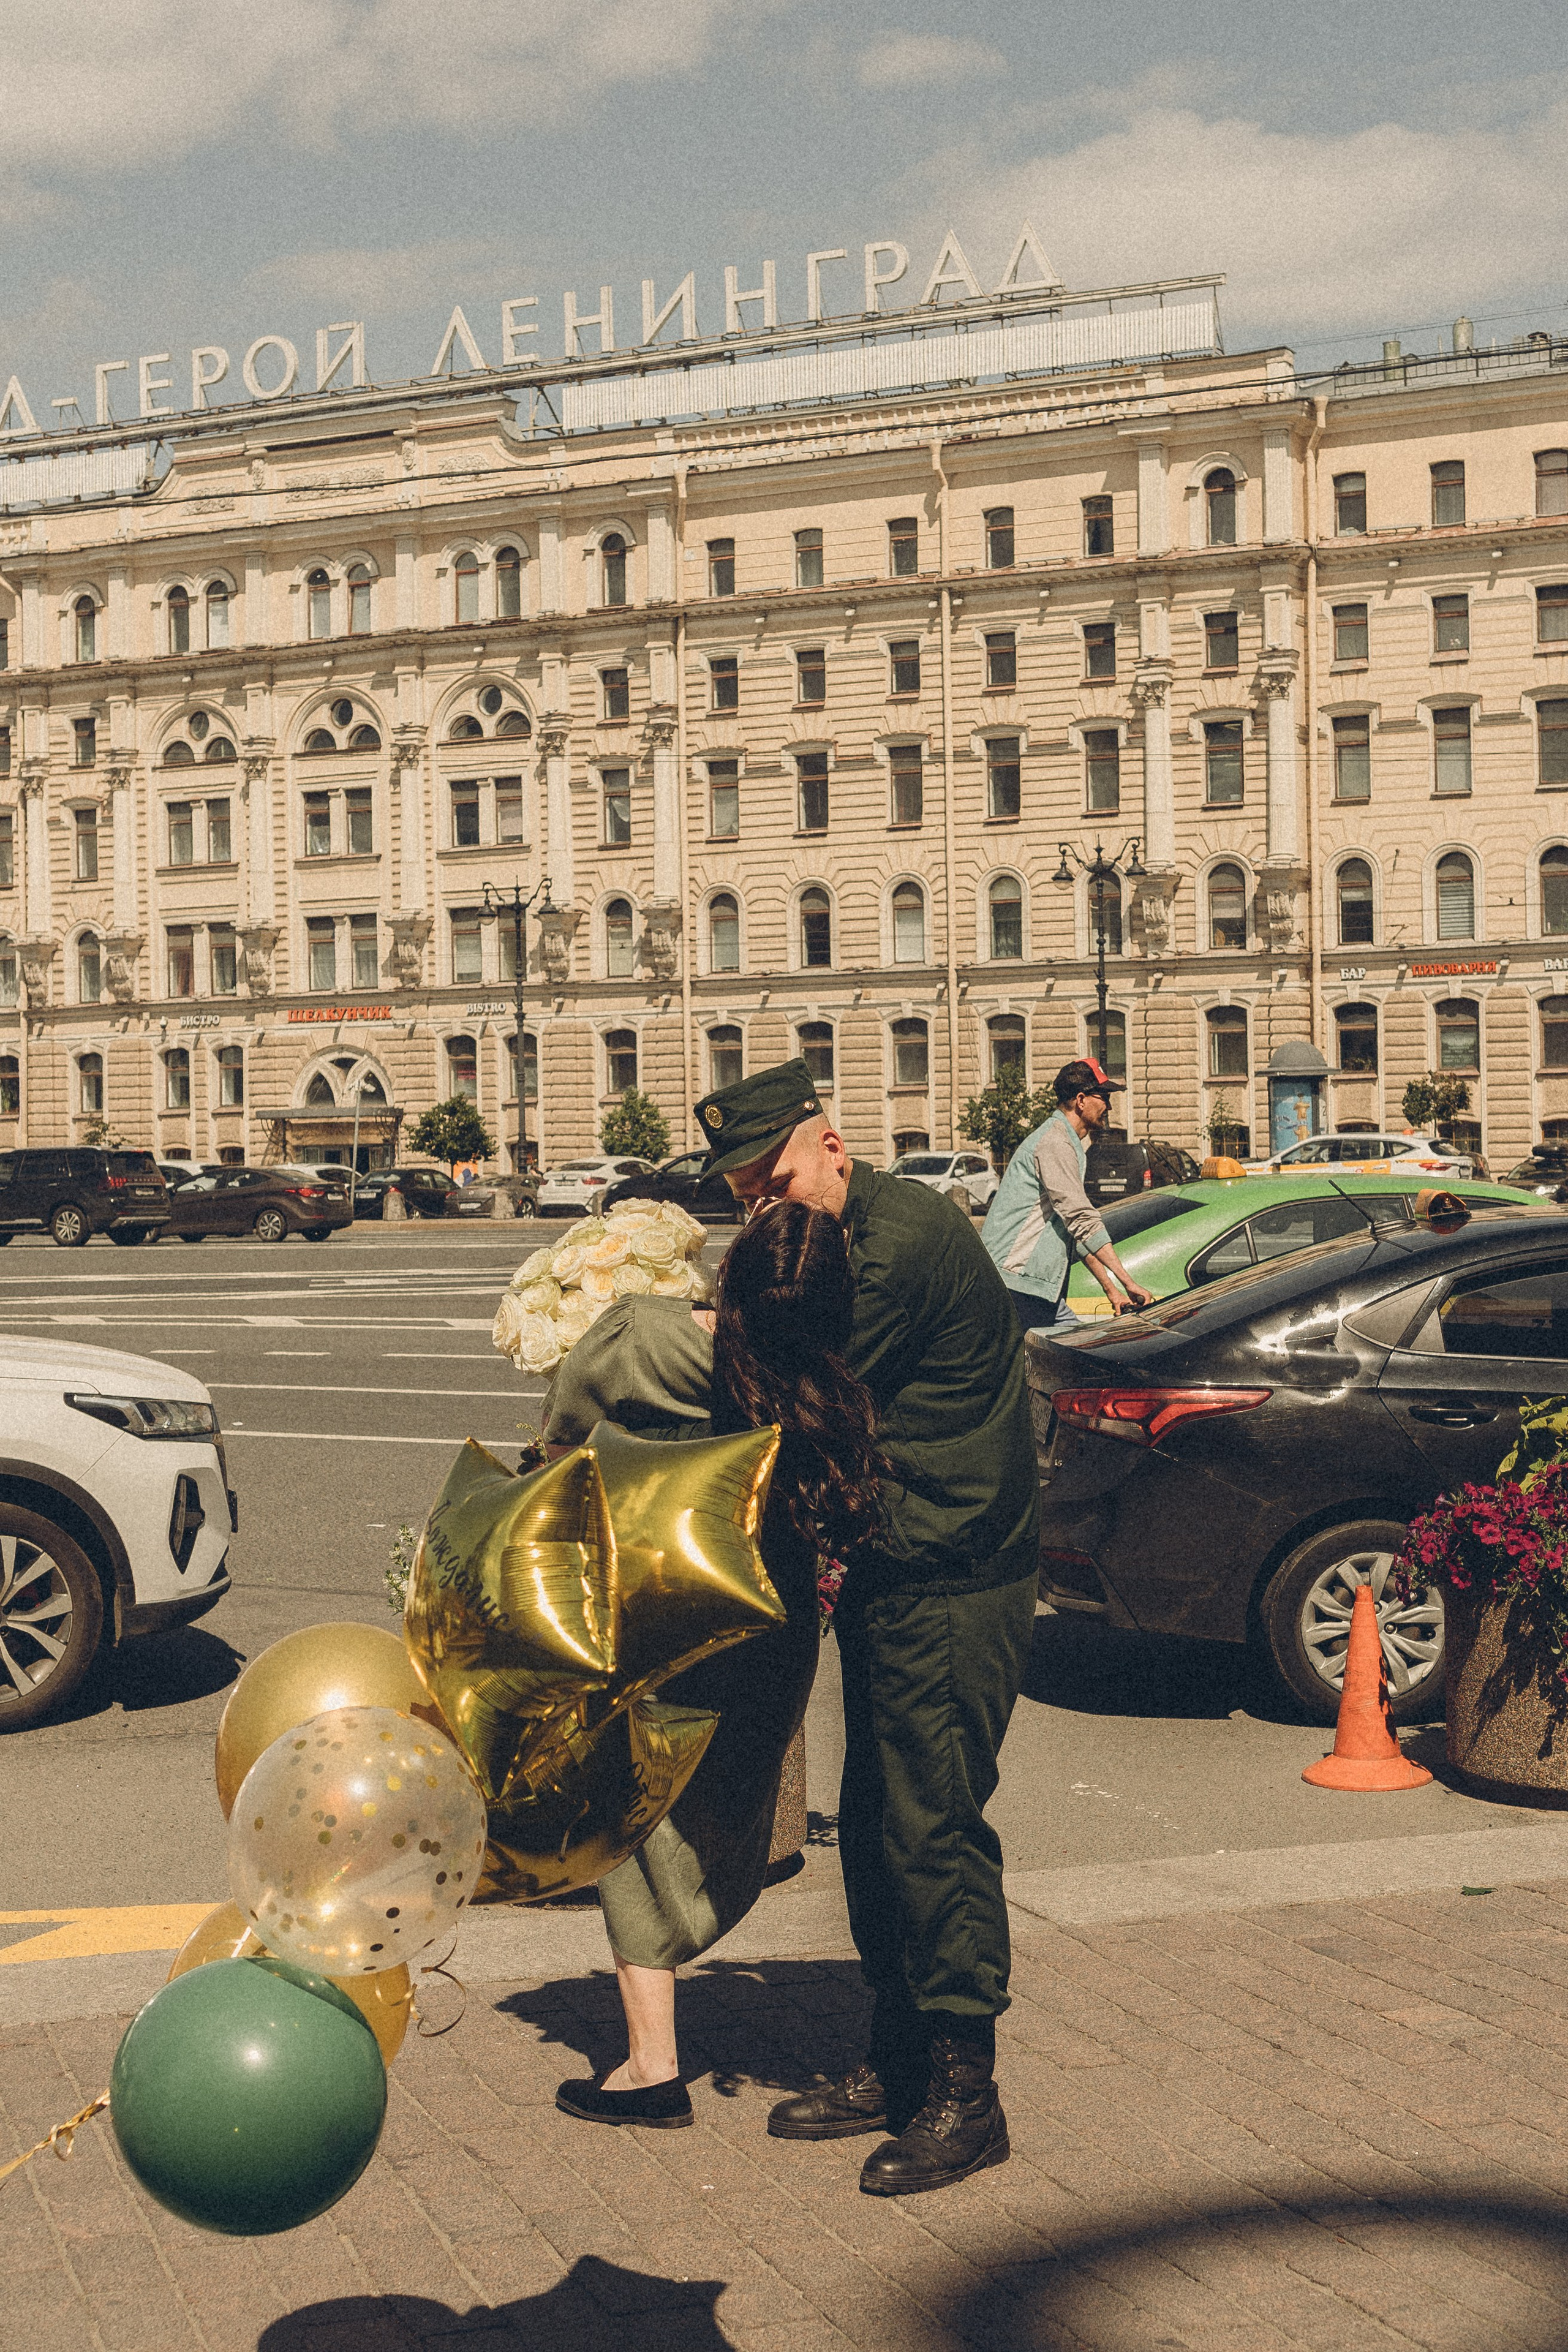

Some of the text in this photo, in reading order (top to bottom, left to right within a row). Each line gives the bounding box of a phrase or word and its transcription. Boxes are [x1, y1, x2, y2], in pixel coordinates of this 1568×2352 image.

[431, 219, 1063, 376] ЛЕНИНГРАД
[1340, 967, 1366, 979] БАР
[1412, 962, 1496, 976] ПИВОВАРНЯ
[288, 1005, 391, 1022] ЩЕЛКУНЧИК
[467, 1002, 506, 1013] BISTRO
[179, 1014, 221, 1026] БИСТРО
